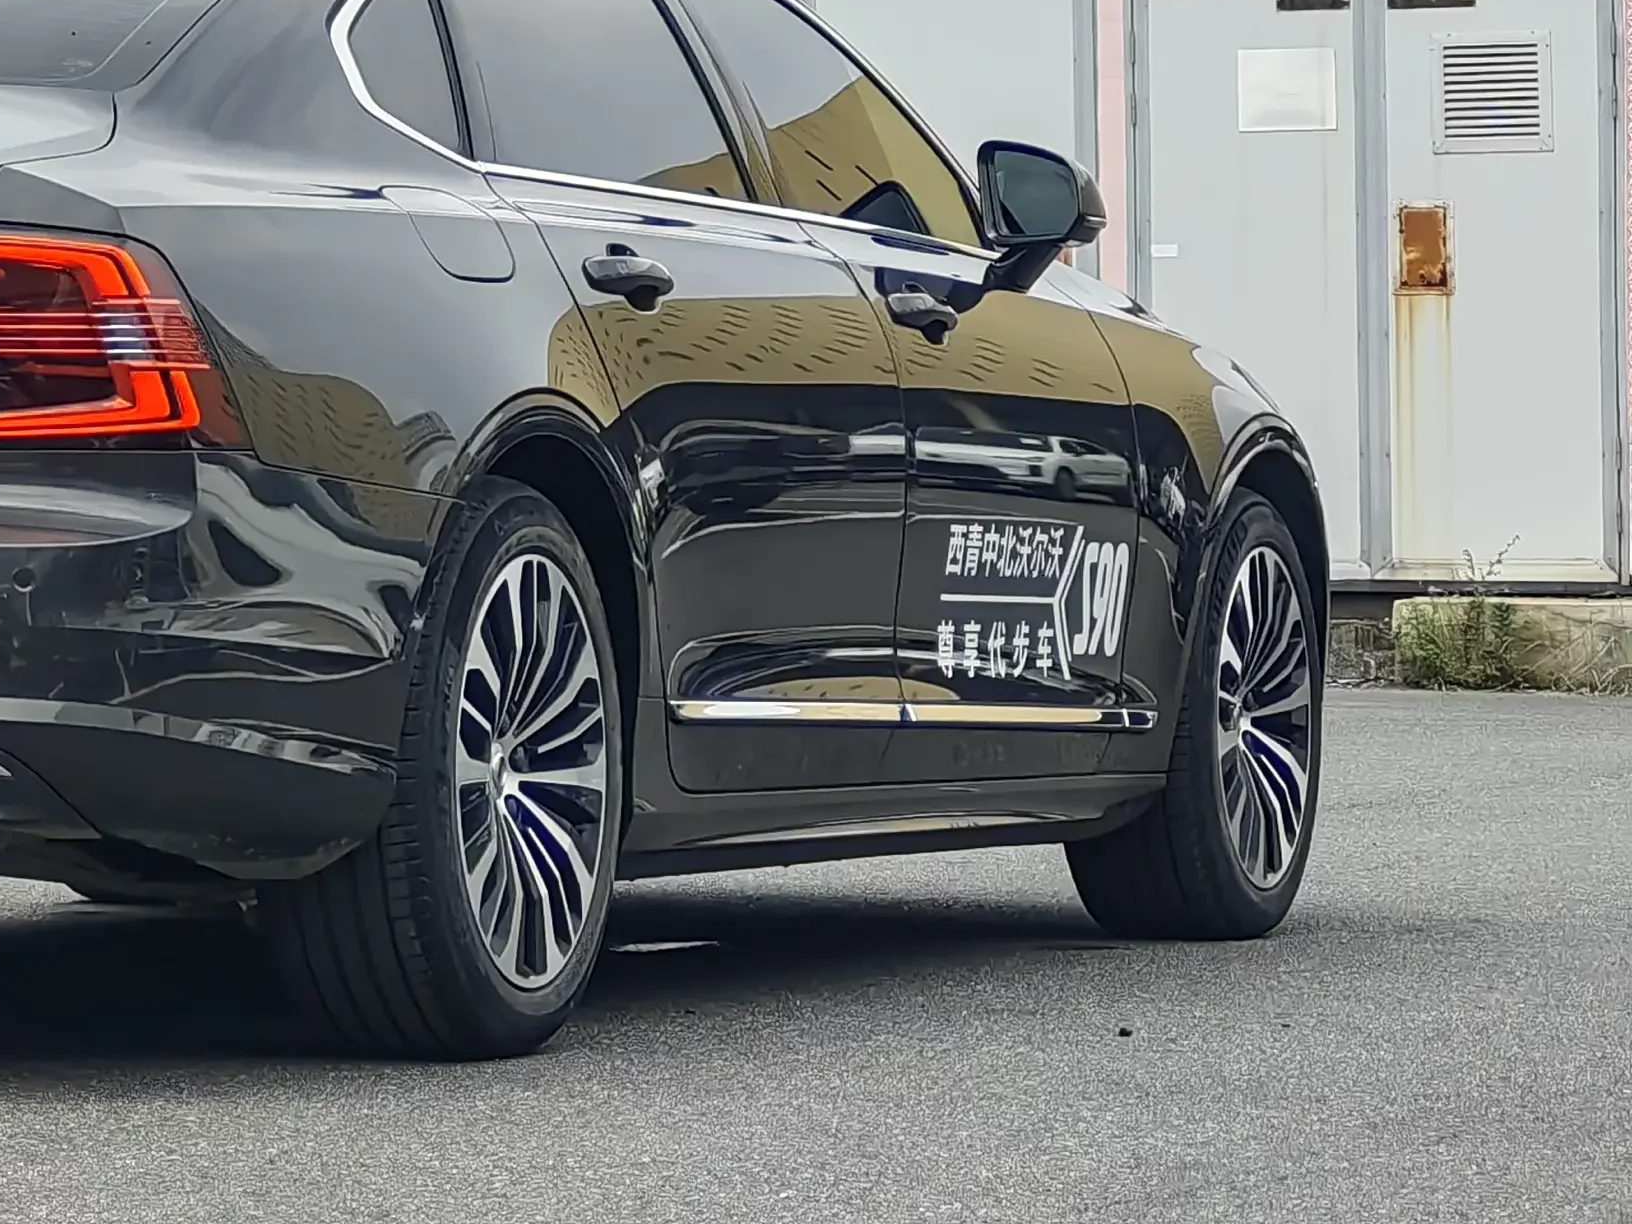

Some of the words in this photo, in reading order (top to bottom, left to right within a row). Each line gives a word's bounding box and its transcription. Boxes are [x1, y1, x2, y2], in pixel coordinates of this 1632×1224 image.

[945, 522, 1065, 578] 西青中北沃尔沃
[1073, 541, 1130, 657] S90
[937, 620, 1055, 679] 尊享代步车
